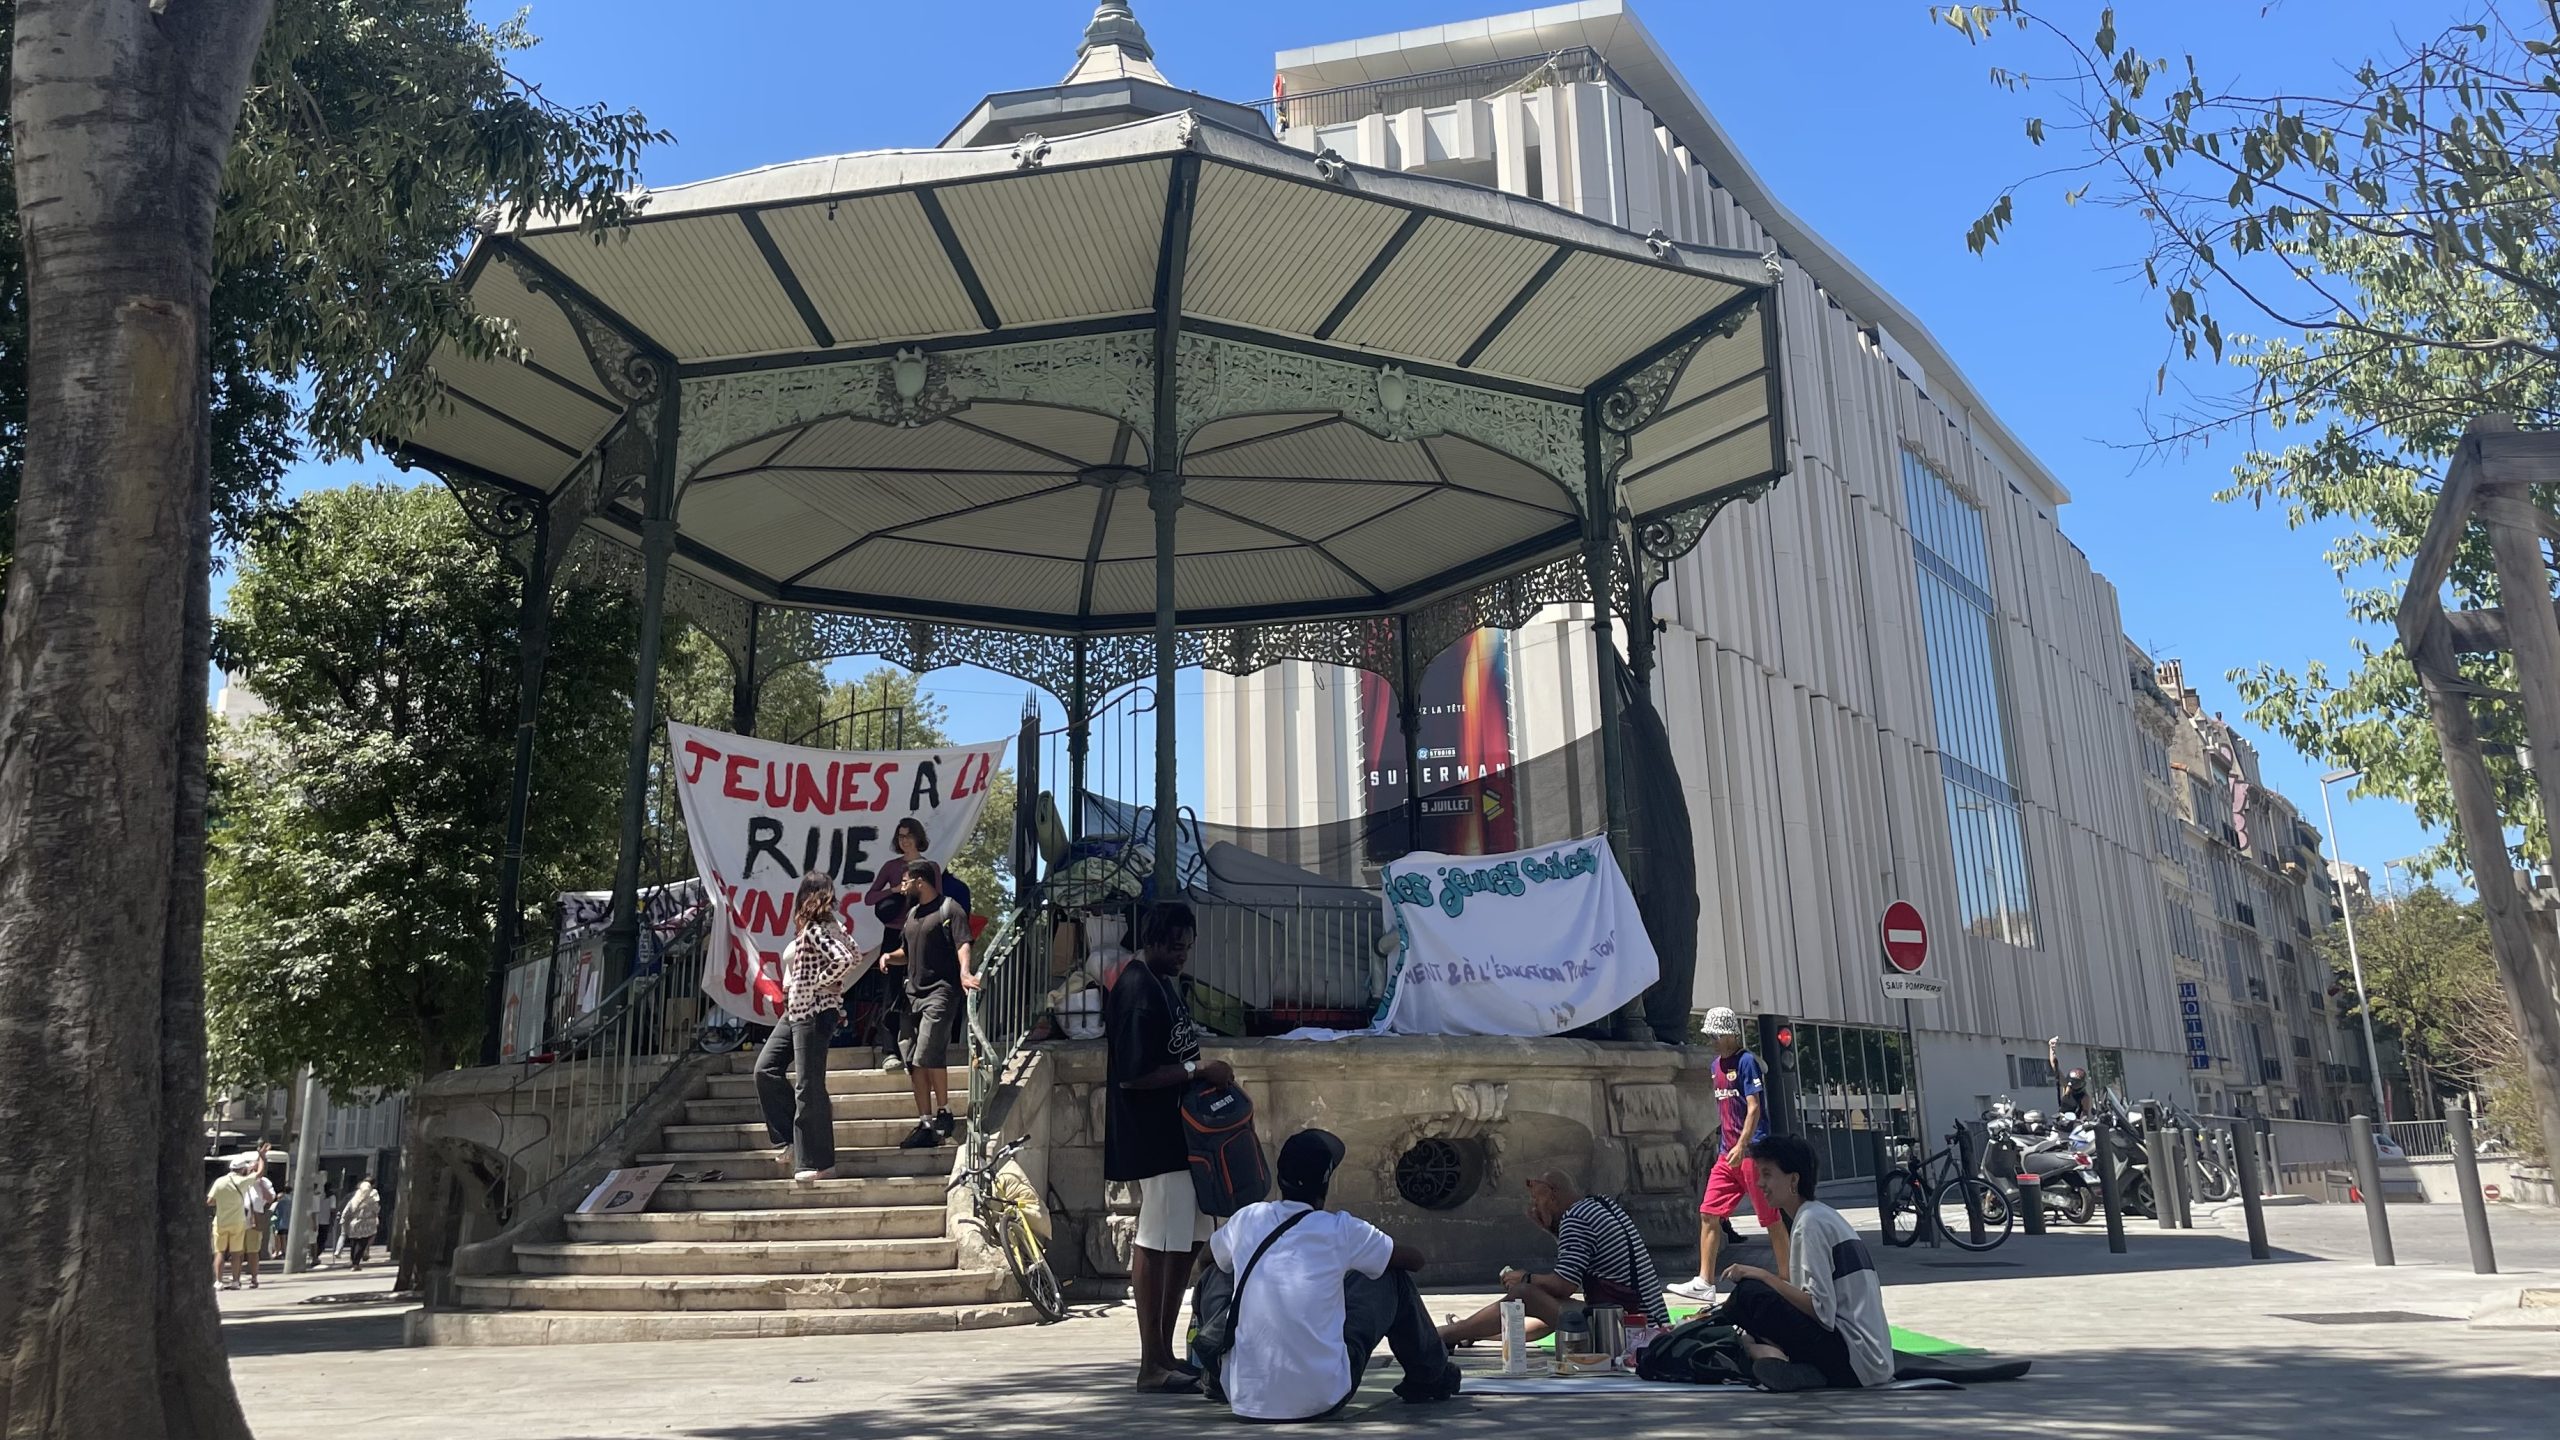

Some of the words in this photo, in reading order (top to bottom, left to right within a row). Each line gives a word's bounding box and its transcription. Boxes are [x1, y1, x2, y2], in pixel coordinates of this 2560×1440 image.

[1431, 705, 1442, 714] LA
[1446, 703, 1467, 713] TÊTE
[684, 740, 899, 815] JEUNES
[909, 754, 942, 811] À
[950, 752, 990, 801] LA
[1370, 763, 1506, 787] SUERMAN
[1421, 801, 1429, 813] 9
[1431, 800, 1469, 812] JUILLET
[742, 816, 879, 885] RUE
[1885, 981, 1903, 990] SAUF
[1905, 982, 1942, 993] POMPIERS
[2182, 984, 2207, 1069] HOTEL
